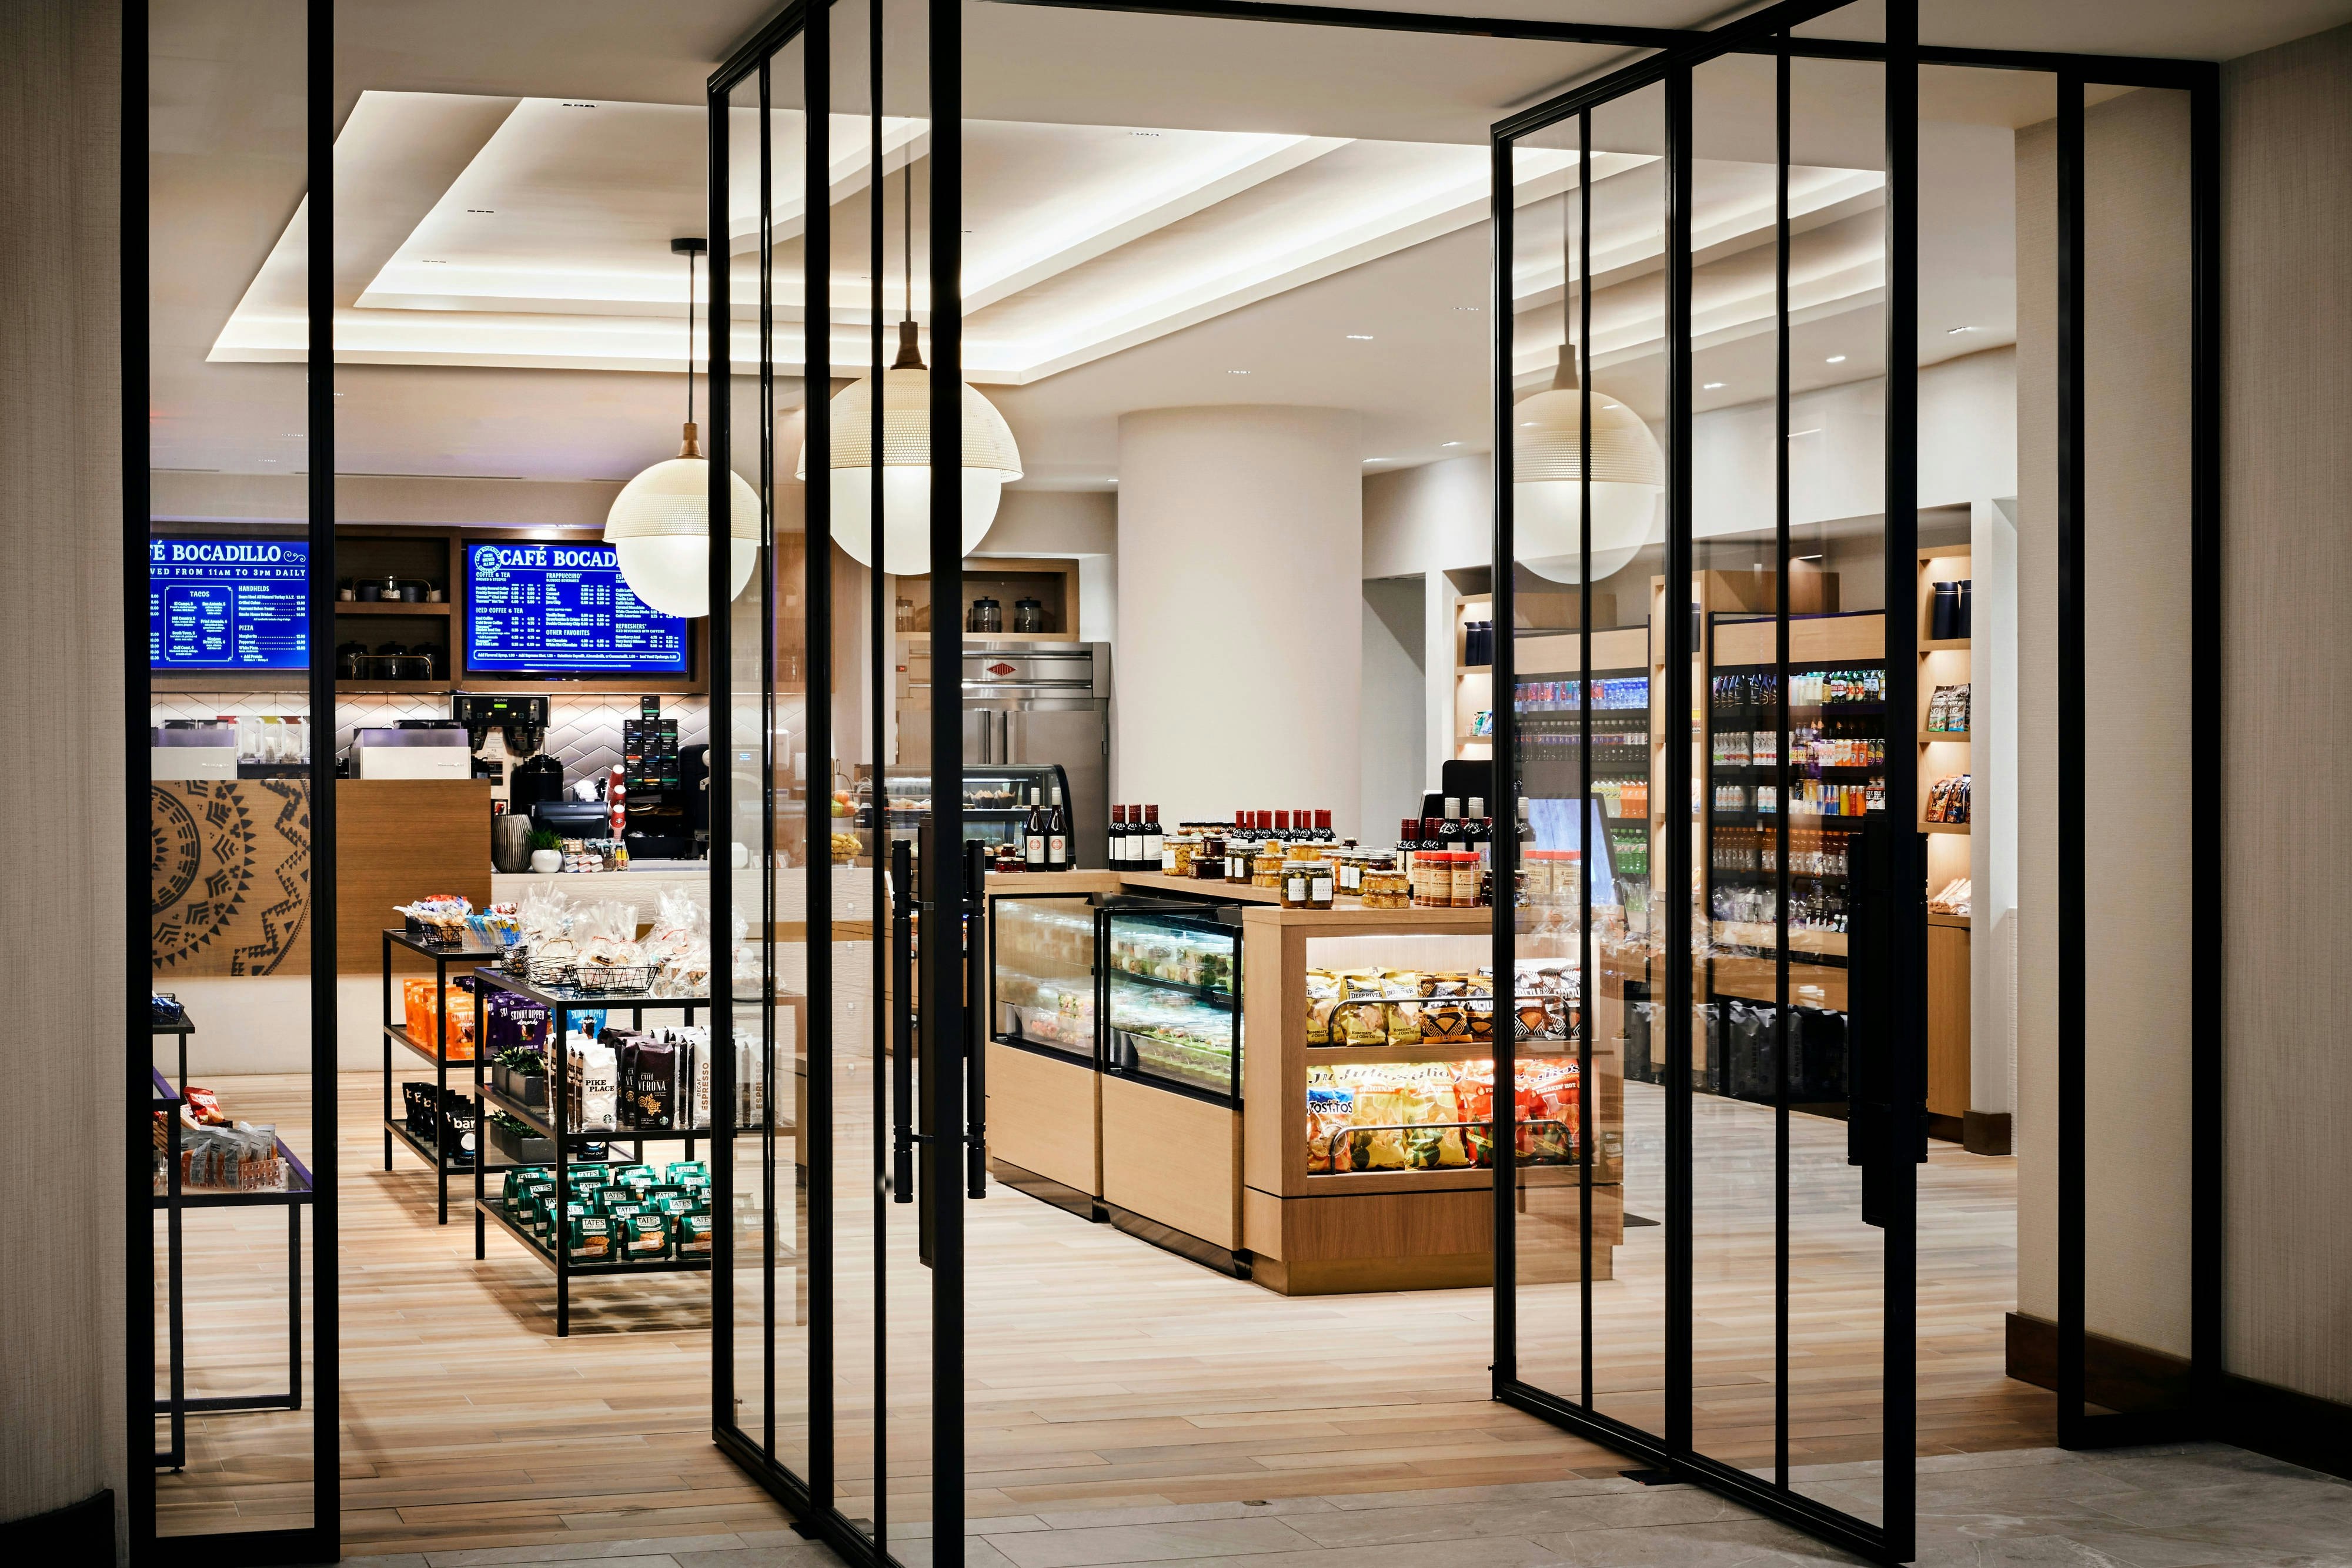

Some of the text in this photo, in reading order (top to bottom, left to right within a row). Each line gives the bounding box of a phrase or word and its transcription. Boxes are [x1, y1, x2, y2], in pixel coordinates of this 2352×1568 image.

[172, 545, 281, 561] BOCADILLO
[500, 546, 619, 567] CAFÉ BOCAD
[511, 1009, 544, 1021] SKINNY DIPPED
[638, 1081, 666, 1091] VERONA
[1309, 1100, 1352, 1114] TOSTITOS
[1471, 1135, 1488, 1144] CAUTION
[531, 1184, 552, 1192] TATE'S
